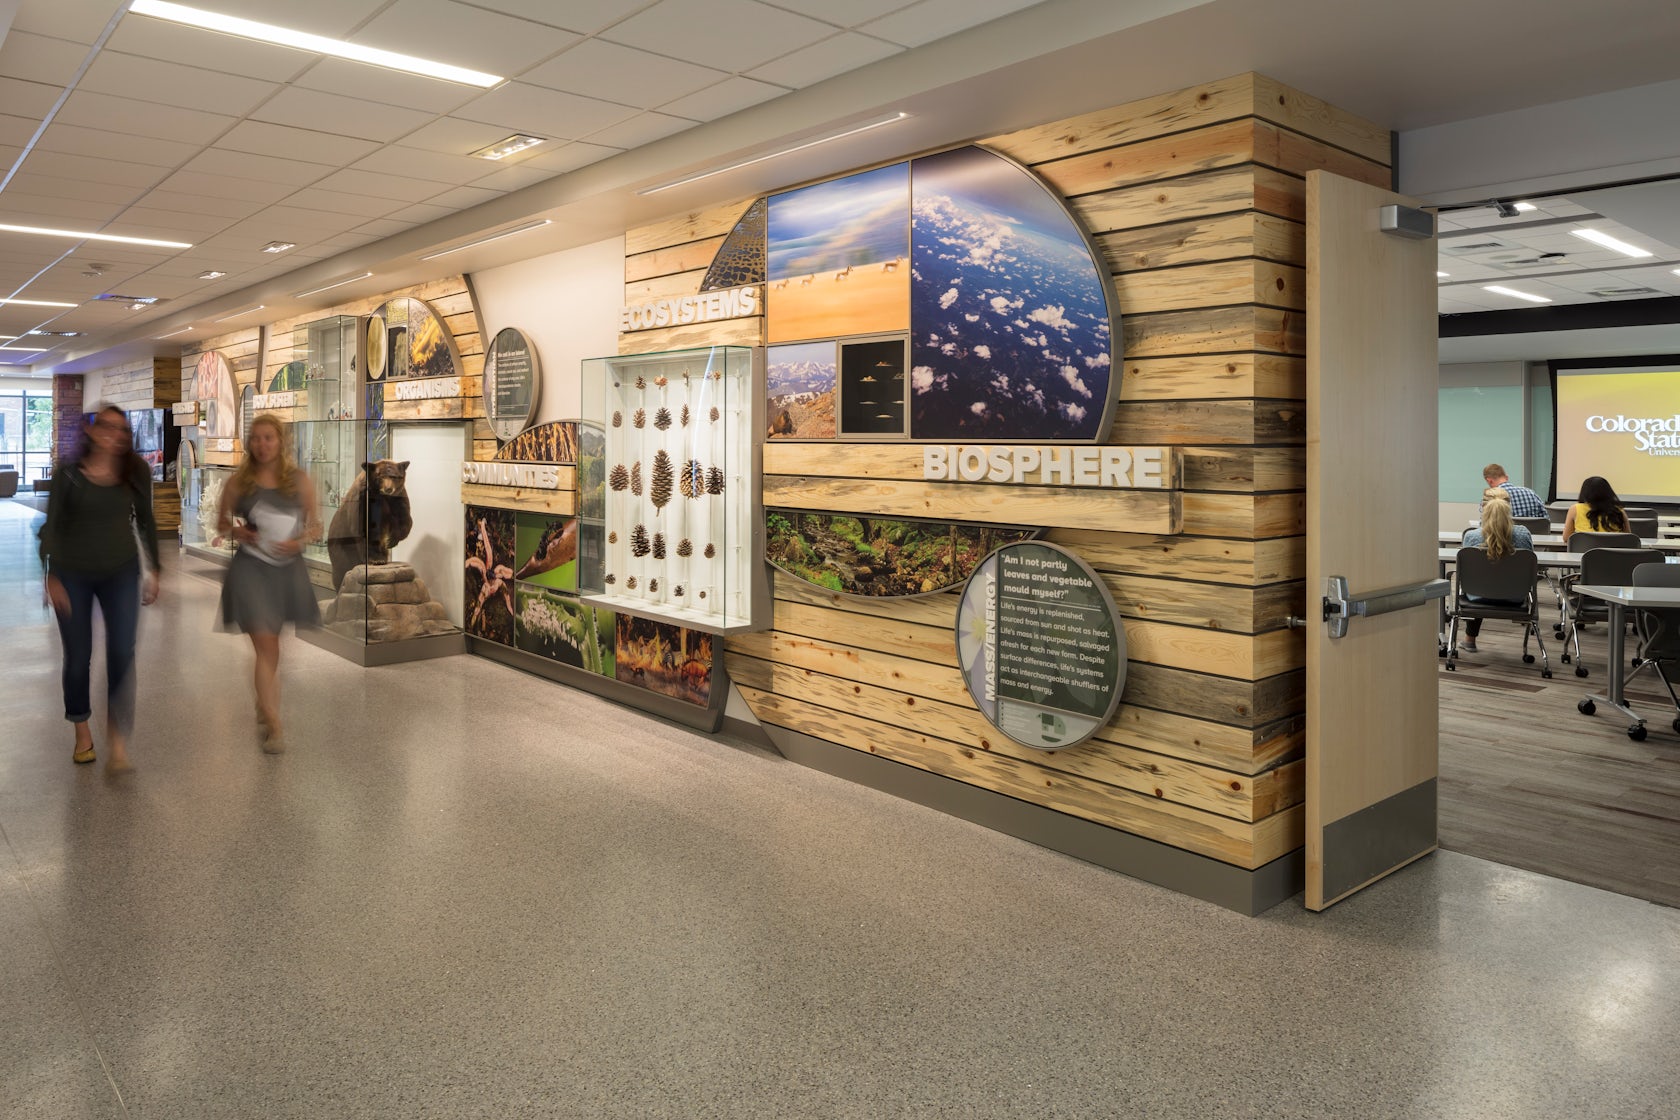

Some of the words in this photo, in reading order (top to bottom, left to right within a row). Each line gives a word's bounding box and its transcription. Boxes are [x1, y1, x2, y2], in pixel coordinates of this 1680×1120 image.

[618, 287, 756, 332] ECOSYSTEMS
[1634, 430, 1680, 451] Stat
[923, 446, 1162, 488] BIOSPHERE
[1020, 557, 1024, 565] I
[1026, 558, 1039, 566] not
[1041, 560, 1068, 572] partly
[1004, 569, 1030, 580] leaves
[1032, 573, 1047, 582] and
[1049, 575, 1092, 588] vegetable
[1004, 584, 1030, 594] mould
[1000, 602, 1015, 610] Life's
[1016, 606, 1038, 615] energy
[1046, 609, 1084, 621] replenished,
[985, 572, 996, 701] MASS/ENERGY
[1000, 615, 1024, 624] sourced
[1025, 618, 1039, 626] from
[1041, 622, 1052, 630] sun
[1054, 622, 1066, 631] and
[1067, 624, 1081, 634] shot
[1083, 628, 1091, 636] as
[1092, 629, 1110, 638] heat.
[1000, 640, 1019, 649] afresh
[1030, 645, 1045, 654] each
[1061, 651, 1078, 660] form.
[1080, 653, 1105, 664] Despite
[1034, 632, 1039, 640] is
[1040, 635, 1078, 646] repurposed,
[1080, 640, 1110, 652] salvaged
[1000, 652, 1022, 662] surface
[1024, 656, 1059, 670] differences,
[1060, 663, 1075, 672] life's
[1076, 667, 1104, 678] systems
[1017, 681, 1029, 689] and
[1030, 684, 1054, 695] energy.
[1020, 668, 1070, 684] interchangeable
[1071, 677, 1100, 690] shufflers
